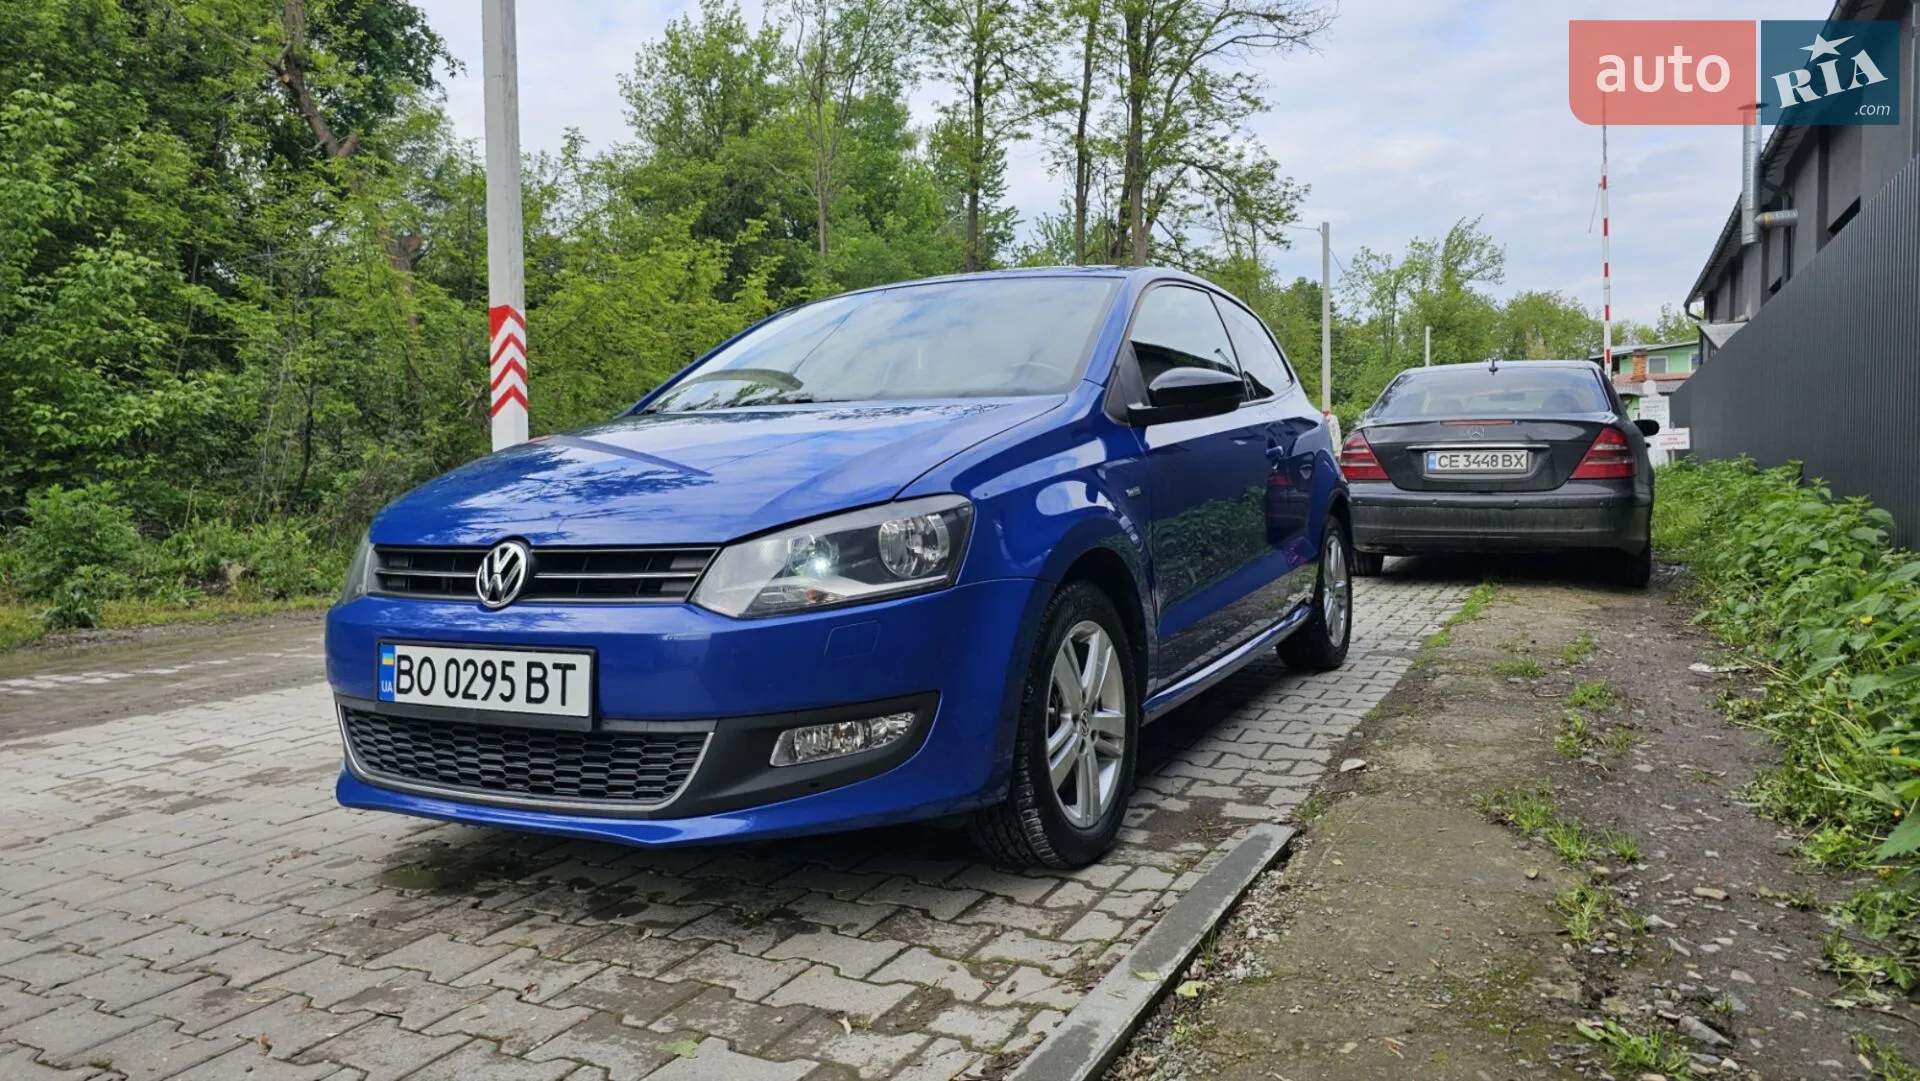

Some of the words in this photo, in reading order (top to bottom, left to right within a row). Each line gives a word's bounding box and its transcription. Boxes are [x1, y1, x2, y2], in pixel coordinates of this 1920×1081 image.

[1438, 454, 1460, 468] CE
[1463, 454, 1499, 468] 3448
[1501, 454, 1525, 468] BX
[381, 680, 393, 693] UA
[396, 654, 436, 697] BO
[444, 657, 516, 703] 0295
[525, 661, 577, 706] BT
